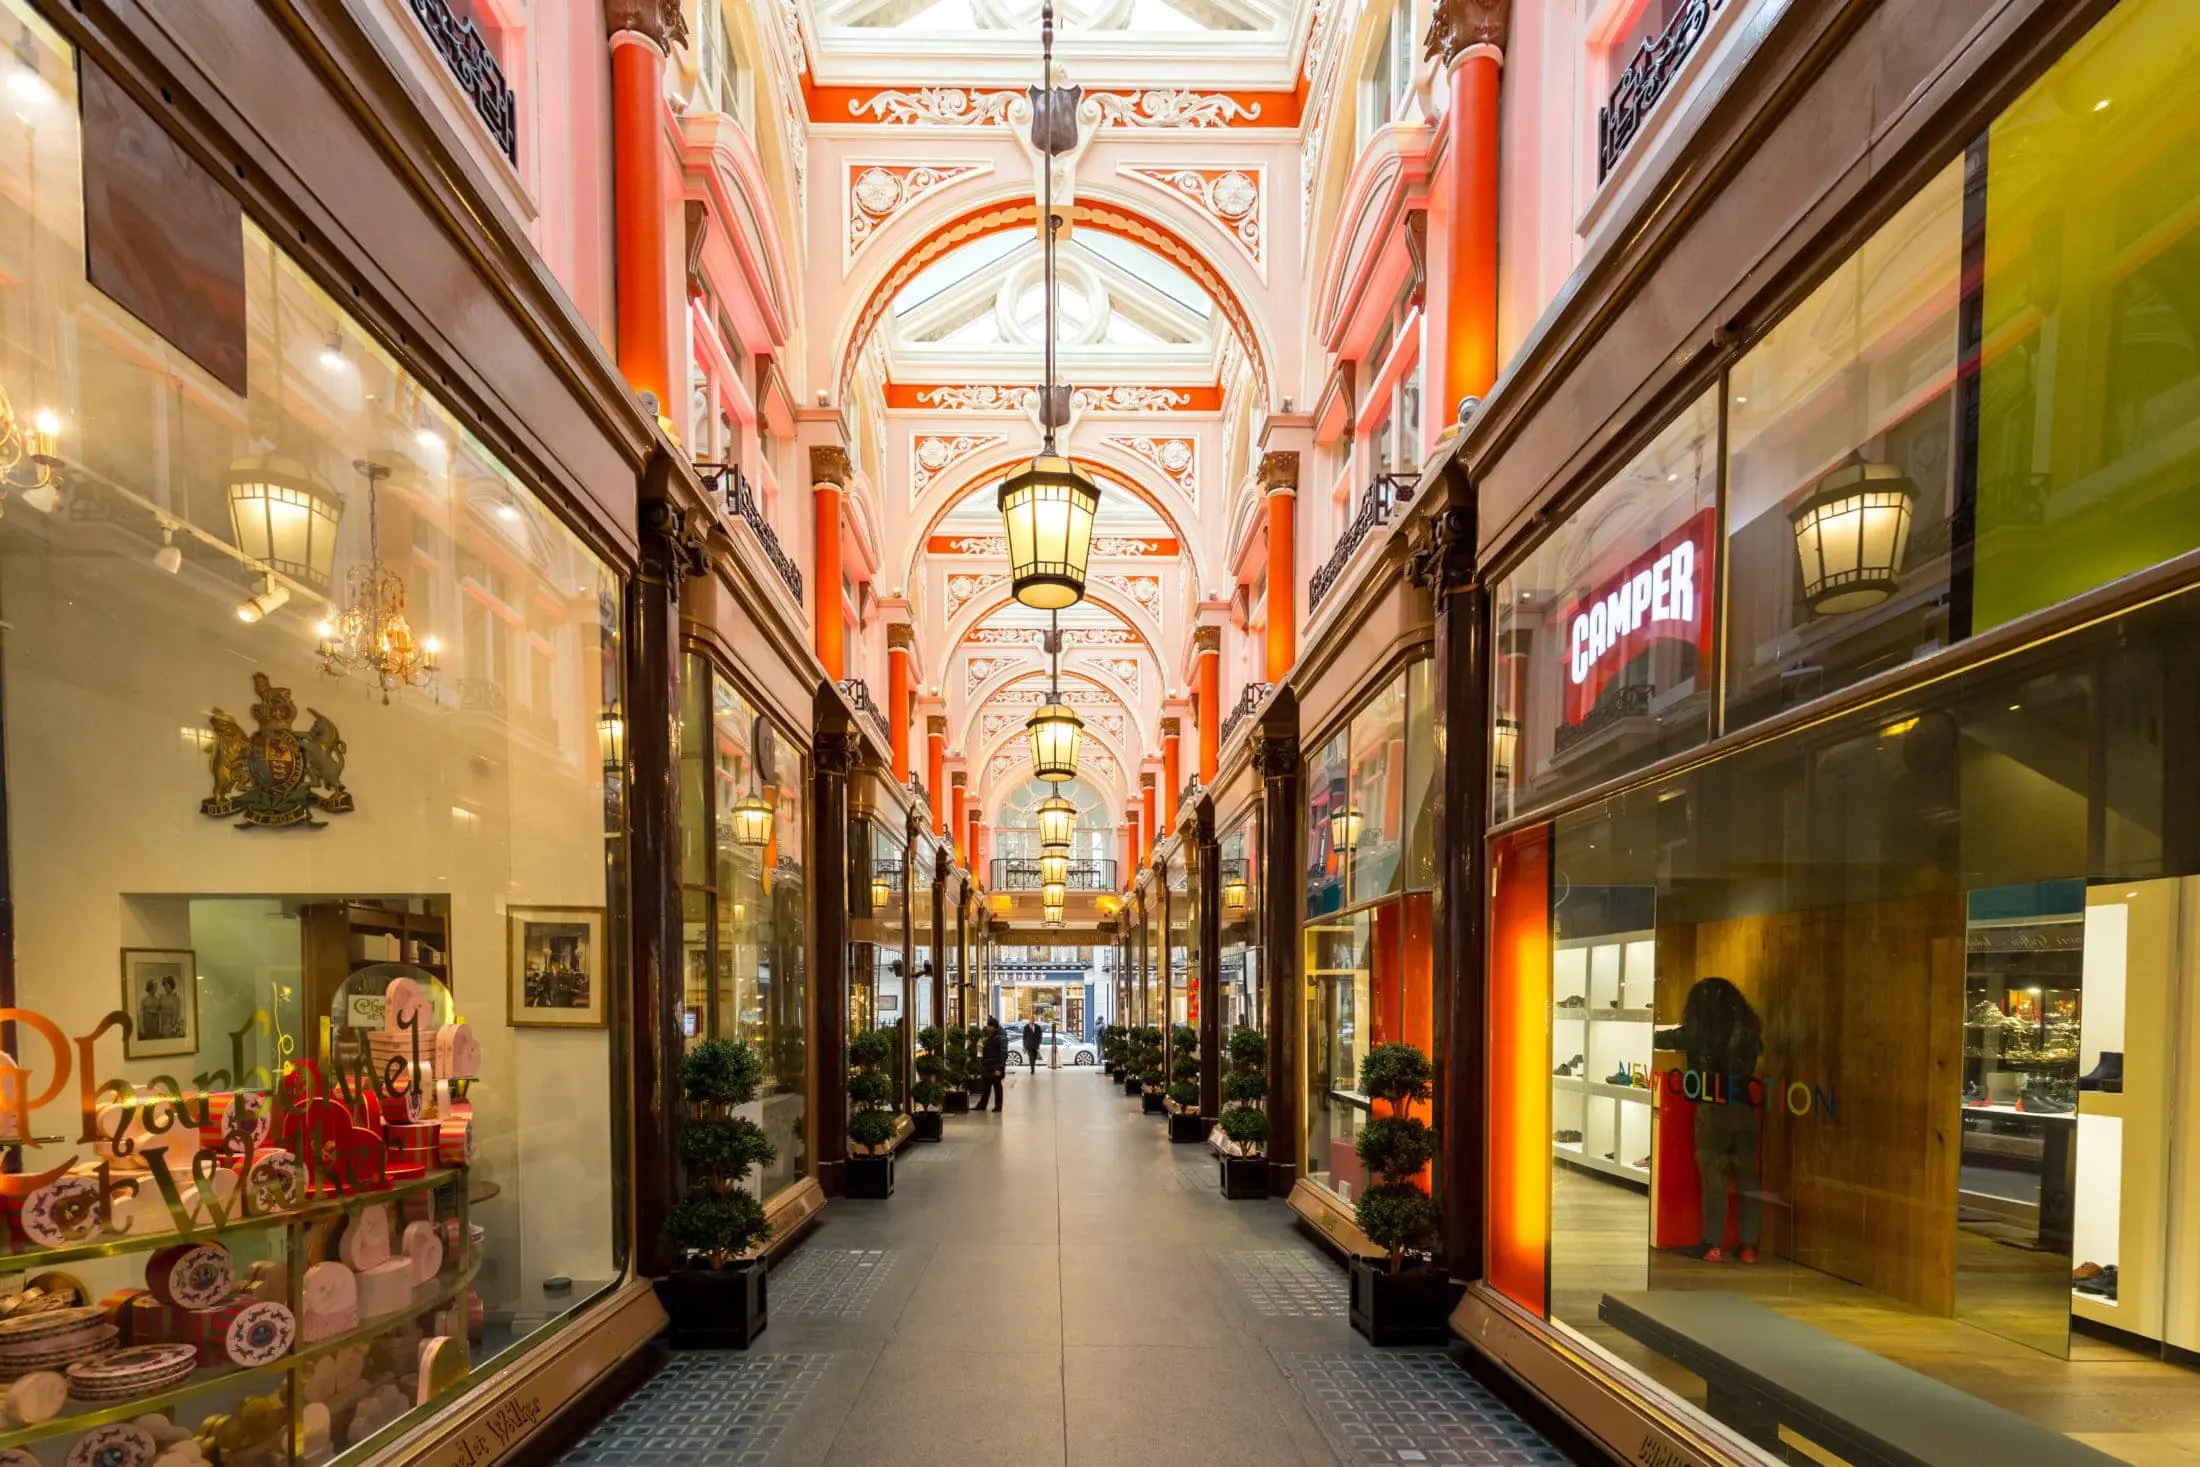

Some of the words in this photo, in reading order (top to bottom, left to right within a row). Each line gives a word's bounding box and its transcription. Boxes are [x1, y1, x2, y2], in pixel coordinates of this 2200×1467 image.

[1571, 540, 1694, 684] CAMPER
[1617, 1060, 1663, 1093] NEW
[1667, 1068, 1836, 1120] COLLECTION
